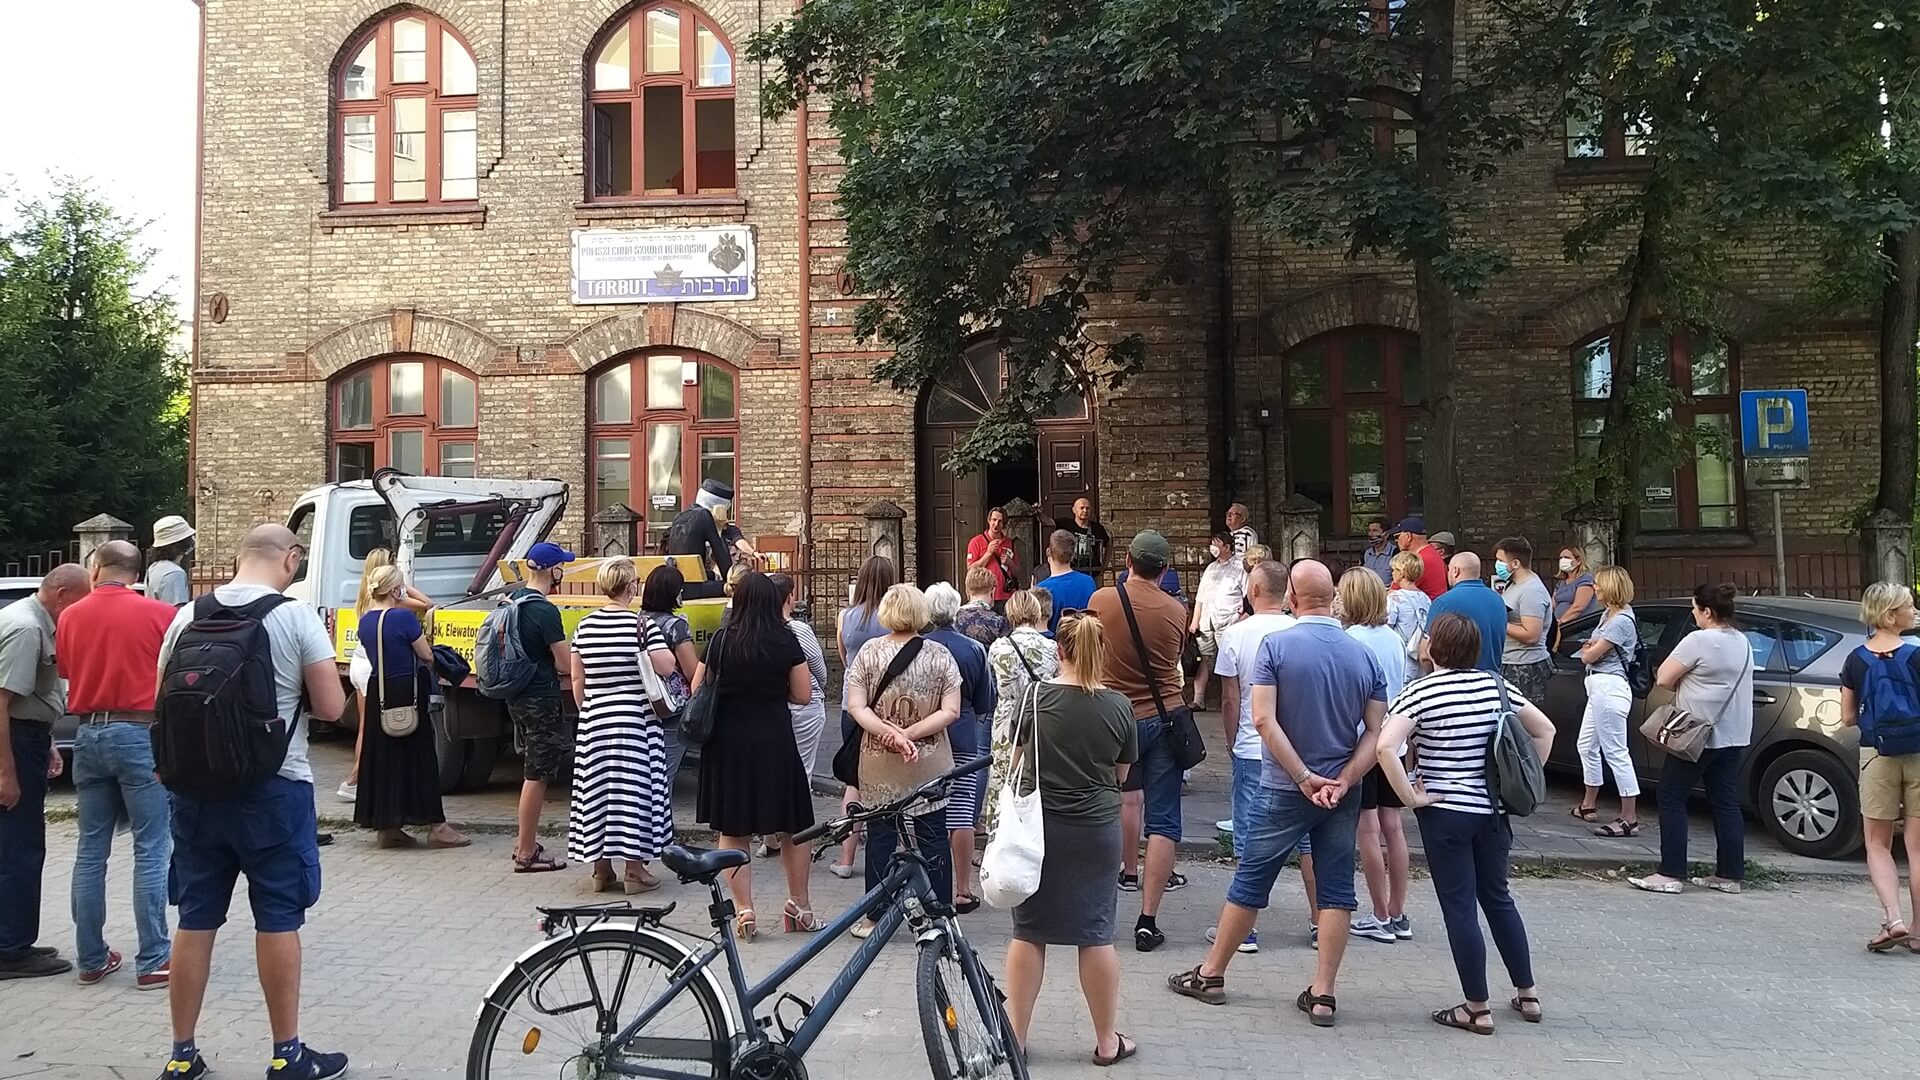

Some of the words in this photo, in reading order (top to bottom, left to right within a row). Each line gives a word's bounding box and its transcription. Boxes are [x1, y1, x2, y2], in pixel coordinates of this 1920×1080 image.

[586, 280, 649, 296] TARBUT
[1756, 397, 1794, 449] P
[446, 623, 478, 638] Elewator
[695, 629, 714, 642] Ele
